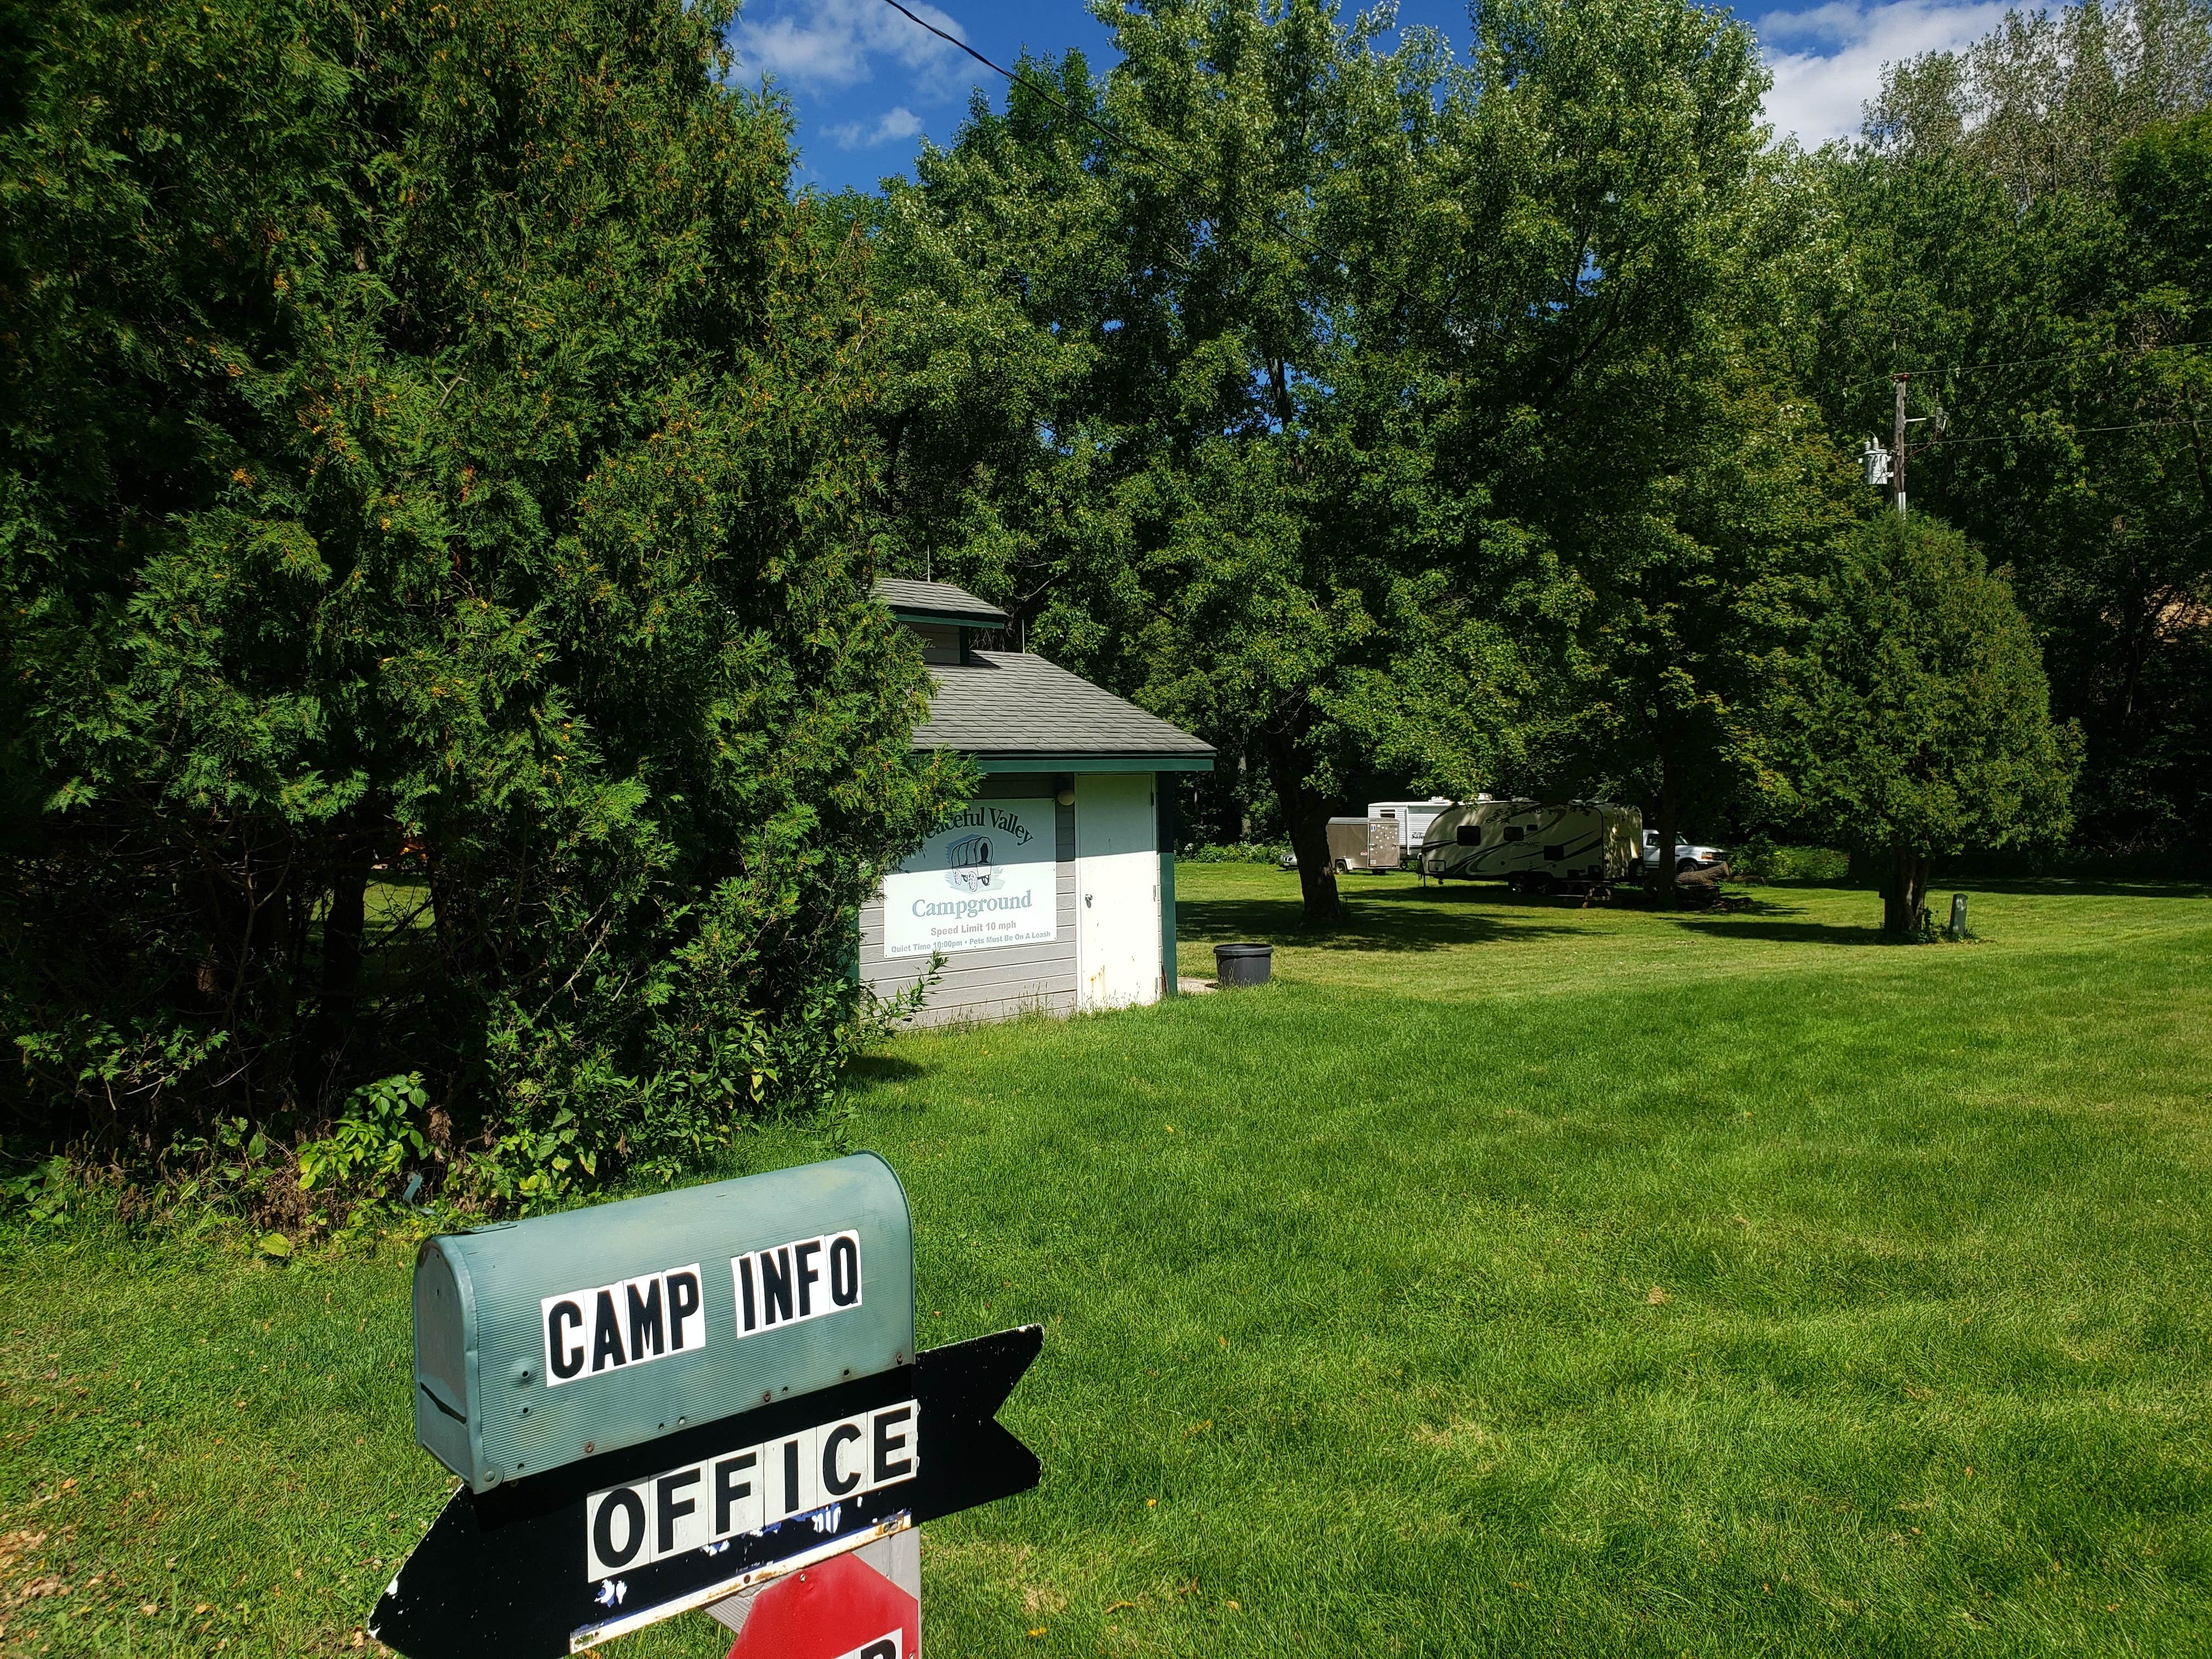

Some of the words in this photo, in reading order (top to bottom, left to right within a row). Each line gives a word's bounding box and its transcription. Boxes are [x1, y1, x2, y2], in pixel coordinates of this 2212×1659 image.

[924, 807, 985, 839] eaceful
[988, 808, 1034, 846] Valley
[912, 889, 1032, 919] Campground
[930, 926, 958, 937] Speed
[961, 923, 983, 933] Limit
[986, 922, 996, 931] 10
[998, 920, 1016, 931] mph
[891, 945, 911, 953] Quiet
[933, 940, 962, 949] 10:00pm
[549, 1271, 699, 1379] CAMP
[739, 1235, 858, 1331] INFO
[593, 1406, 911, 1568] OFFICE
